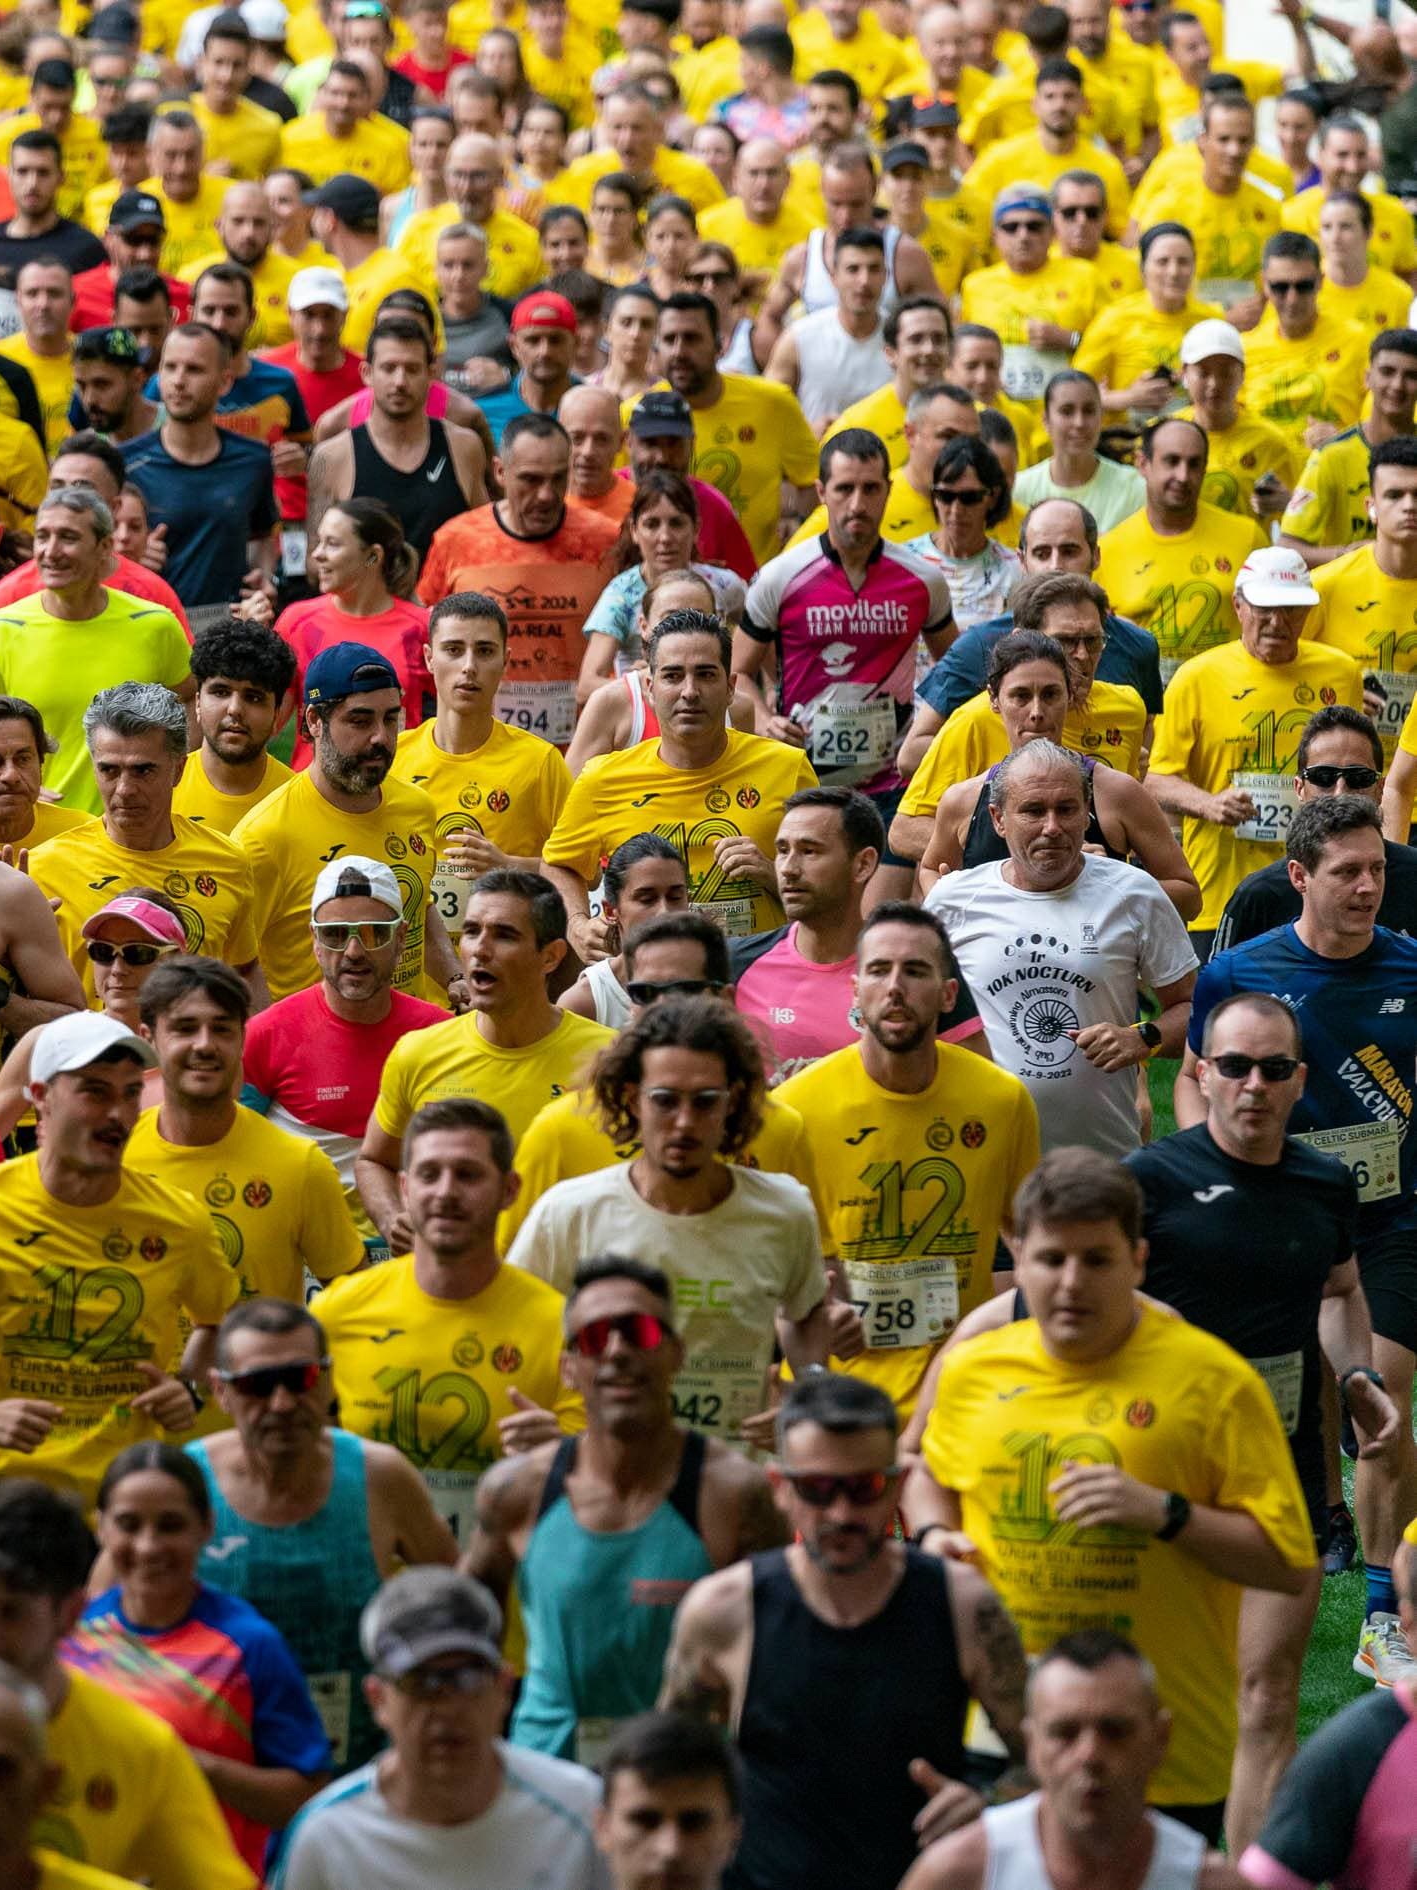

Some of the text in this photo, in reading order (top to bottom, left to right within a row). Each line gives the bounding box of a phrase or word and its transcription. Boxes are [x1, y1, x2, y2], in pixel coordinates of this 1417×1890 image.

[542, 595, 578, 609] 2024
[806, 599, 909, 621] movilclic
[508, 623, 563, 637] A-REAL
[808, 620, 908, 636] TEAM MORELLA
[500, 708, 550, 732] 794
[820, 729, 870, 753] 262
[1030, 951, 1046, 963] 1r
[986, 965, 1097, 997] 10K NOCTURN
[1008, 1001, 1024, 1036] Running
[1020, 986, 1070, 1001] Almassora
[1019, 1068, 1073, 1080] 24-9-2022
[317, 1085, 350, 1095] FIND YOUR
[317, 1092, 345, 1101] EVEREST
[1313, 1131, 1347, 1146] CELTIC
[1352, 1160, 1370, 1188] 6
[859, 1156, 967, 1258] 12
[32, 1265, 145, 1363] 12
[848, 1298, 916, 1332] 758
[9, 1376, 67, 1395] CELTIC
[373, 1368, 491, 1470] 12
